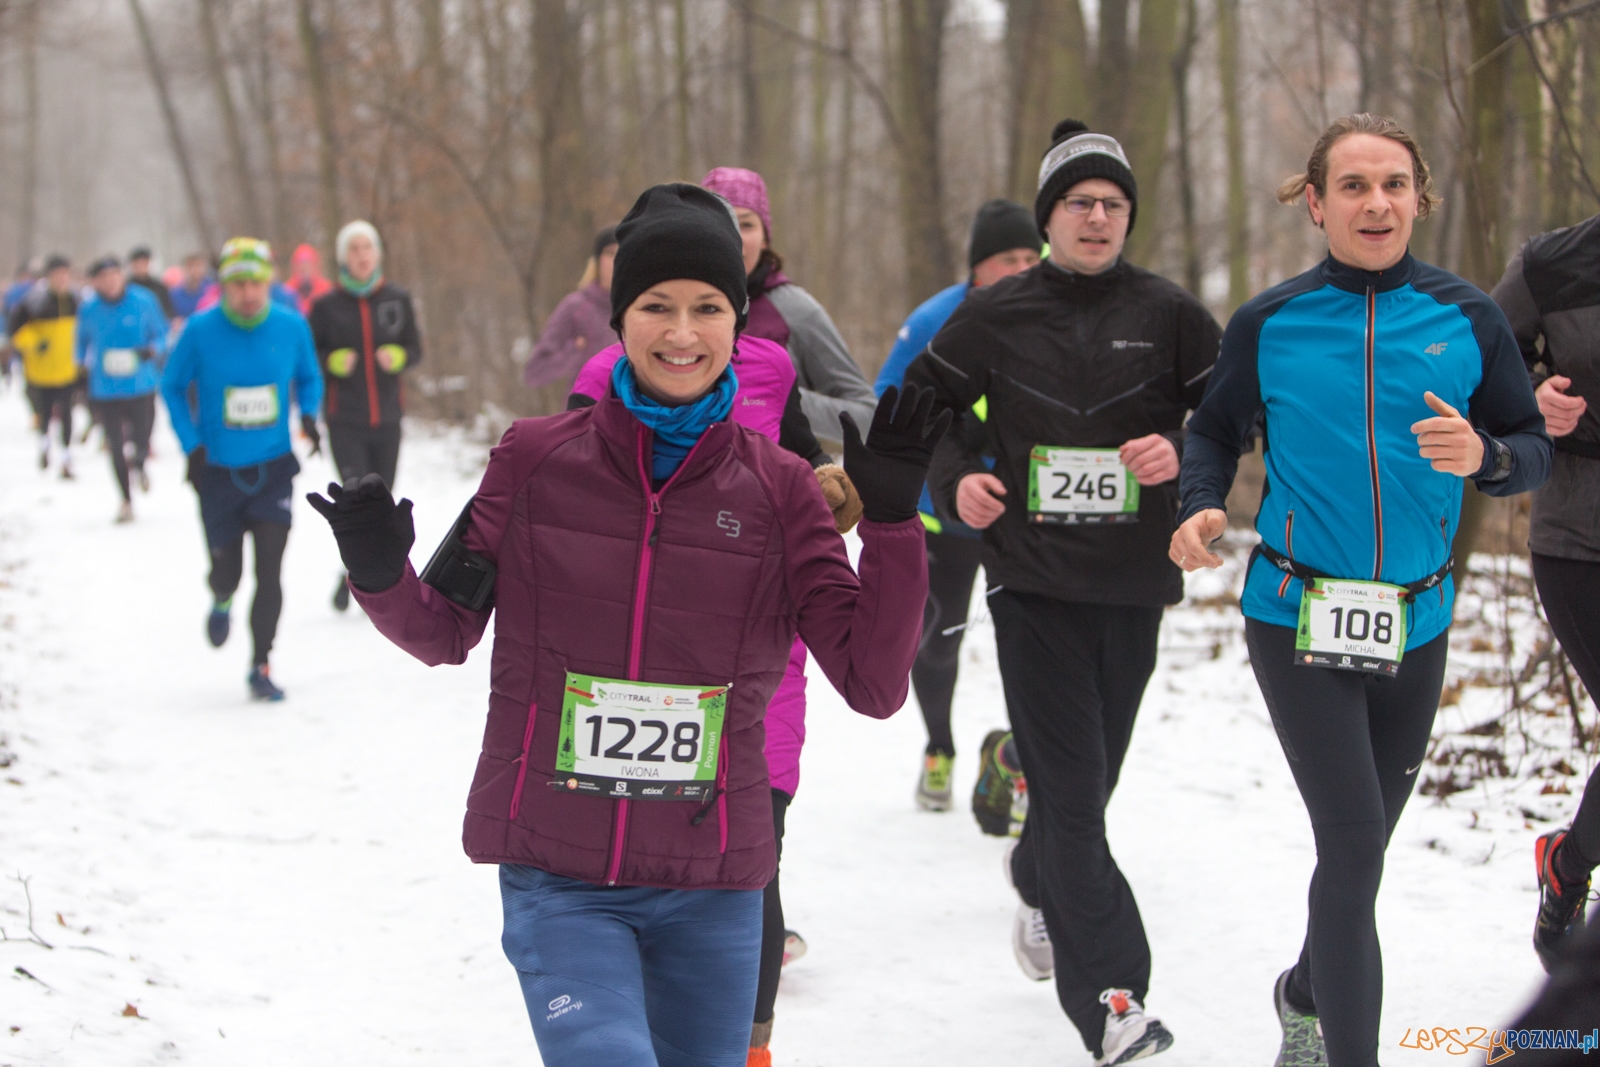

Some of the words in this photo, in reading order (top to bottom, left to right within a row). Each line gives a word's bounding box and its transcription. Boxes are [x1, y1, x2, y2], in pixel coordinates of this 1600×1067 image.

[1424, 341, 1448, 356] 4F
[1051, 471, 1117, 500] 246
[1329, 606, 1393, 645] 108
[1344, 643, 1377, 656] MICHAŁ
[585, 714, 700, 764] 1228
[620, 765, 660, 778] IWONA
